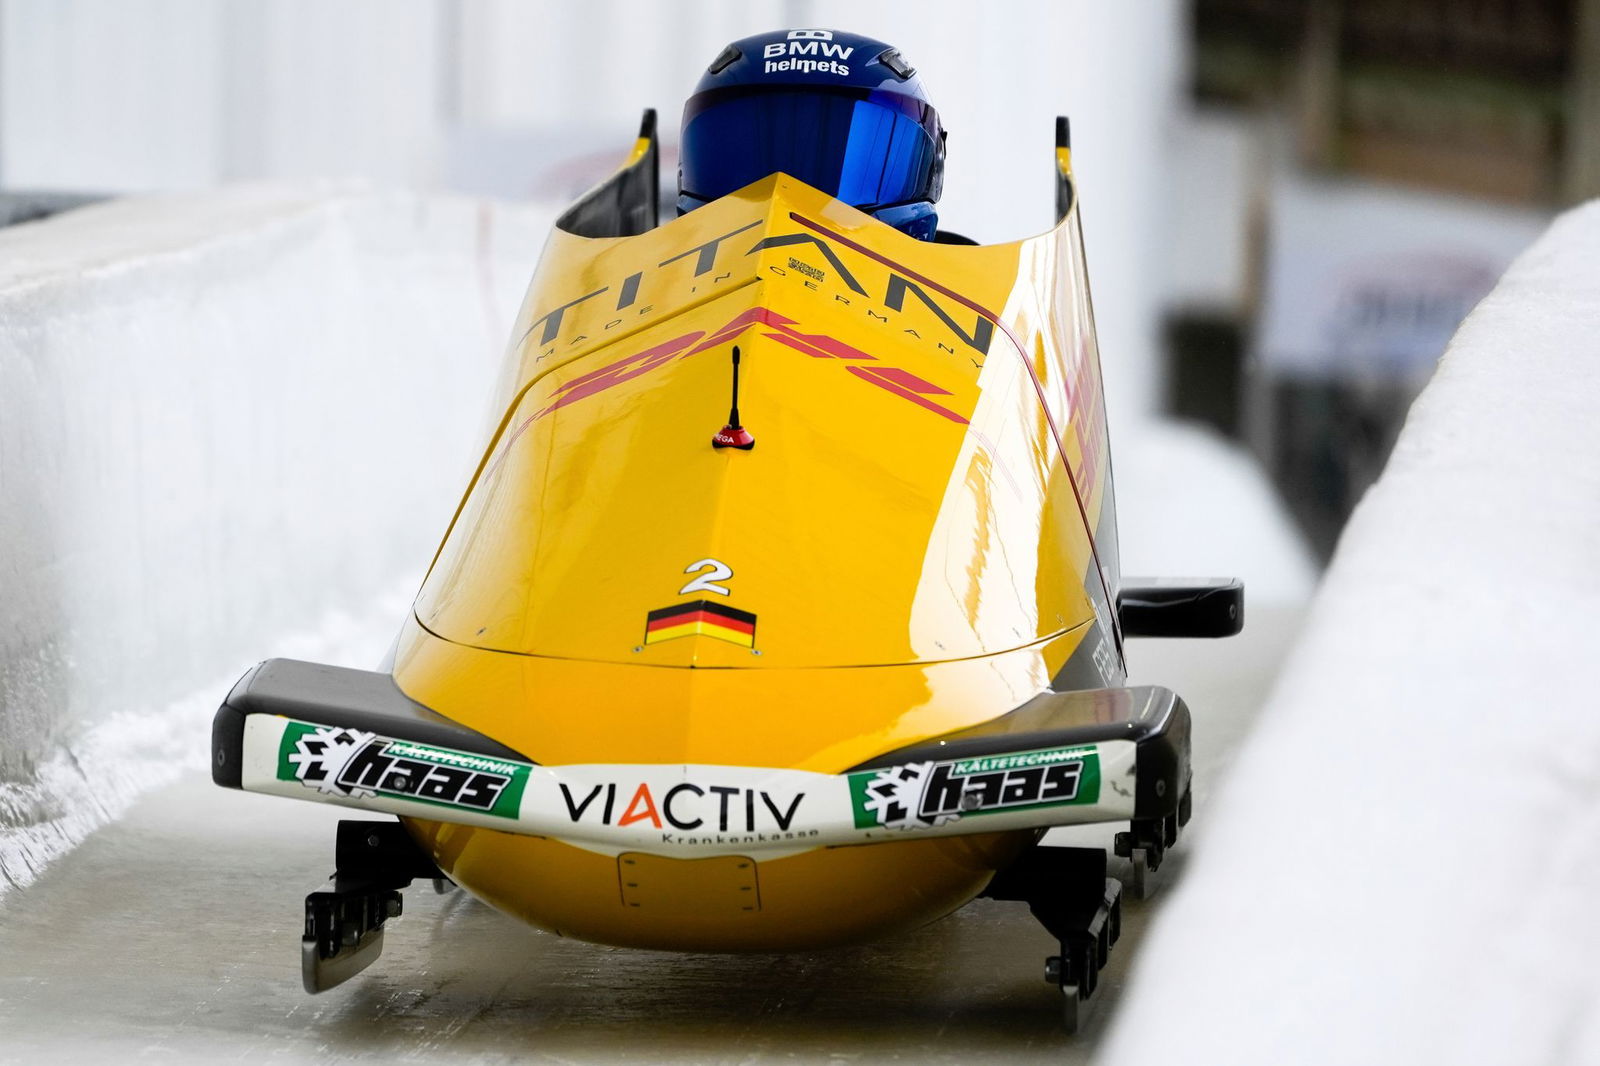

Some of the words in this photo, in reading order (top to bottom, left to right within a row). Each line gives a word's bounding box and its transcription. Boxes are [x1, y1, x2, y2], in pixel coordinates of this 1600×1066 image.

[763, 41, 854, 60] BMW
[764, 57, 850, 76] helmets
[516, 219, 994, 356] TITAN
[536, 304, 655, 363] MADE
[690, 272, 732, 293] IN
[769, 265, 984, 369] GERMANY
[677, 557, 734, 597] 2
[340, 738, 509, 810] haas
[388, 741, 520, 776] KÄLTETECHNIK
[559, 782, 806, 832] VIACTIV
[921, 762, 1082, 815] haas
[662, 828, 821, 846] Krankenkasse
